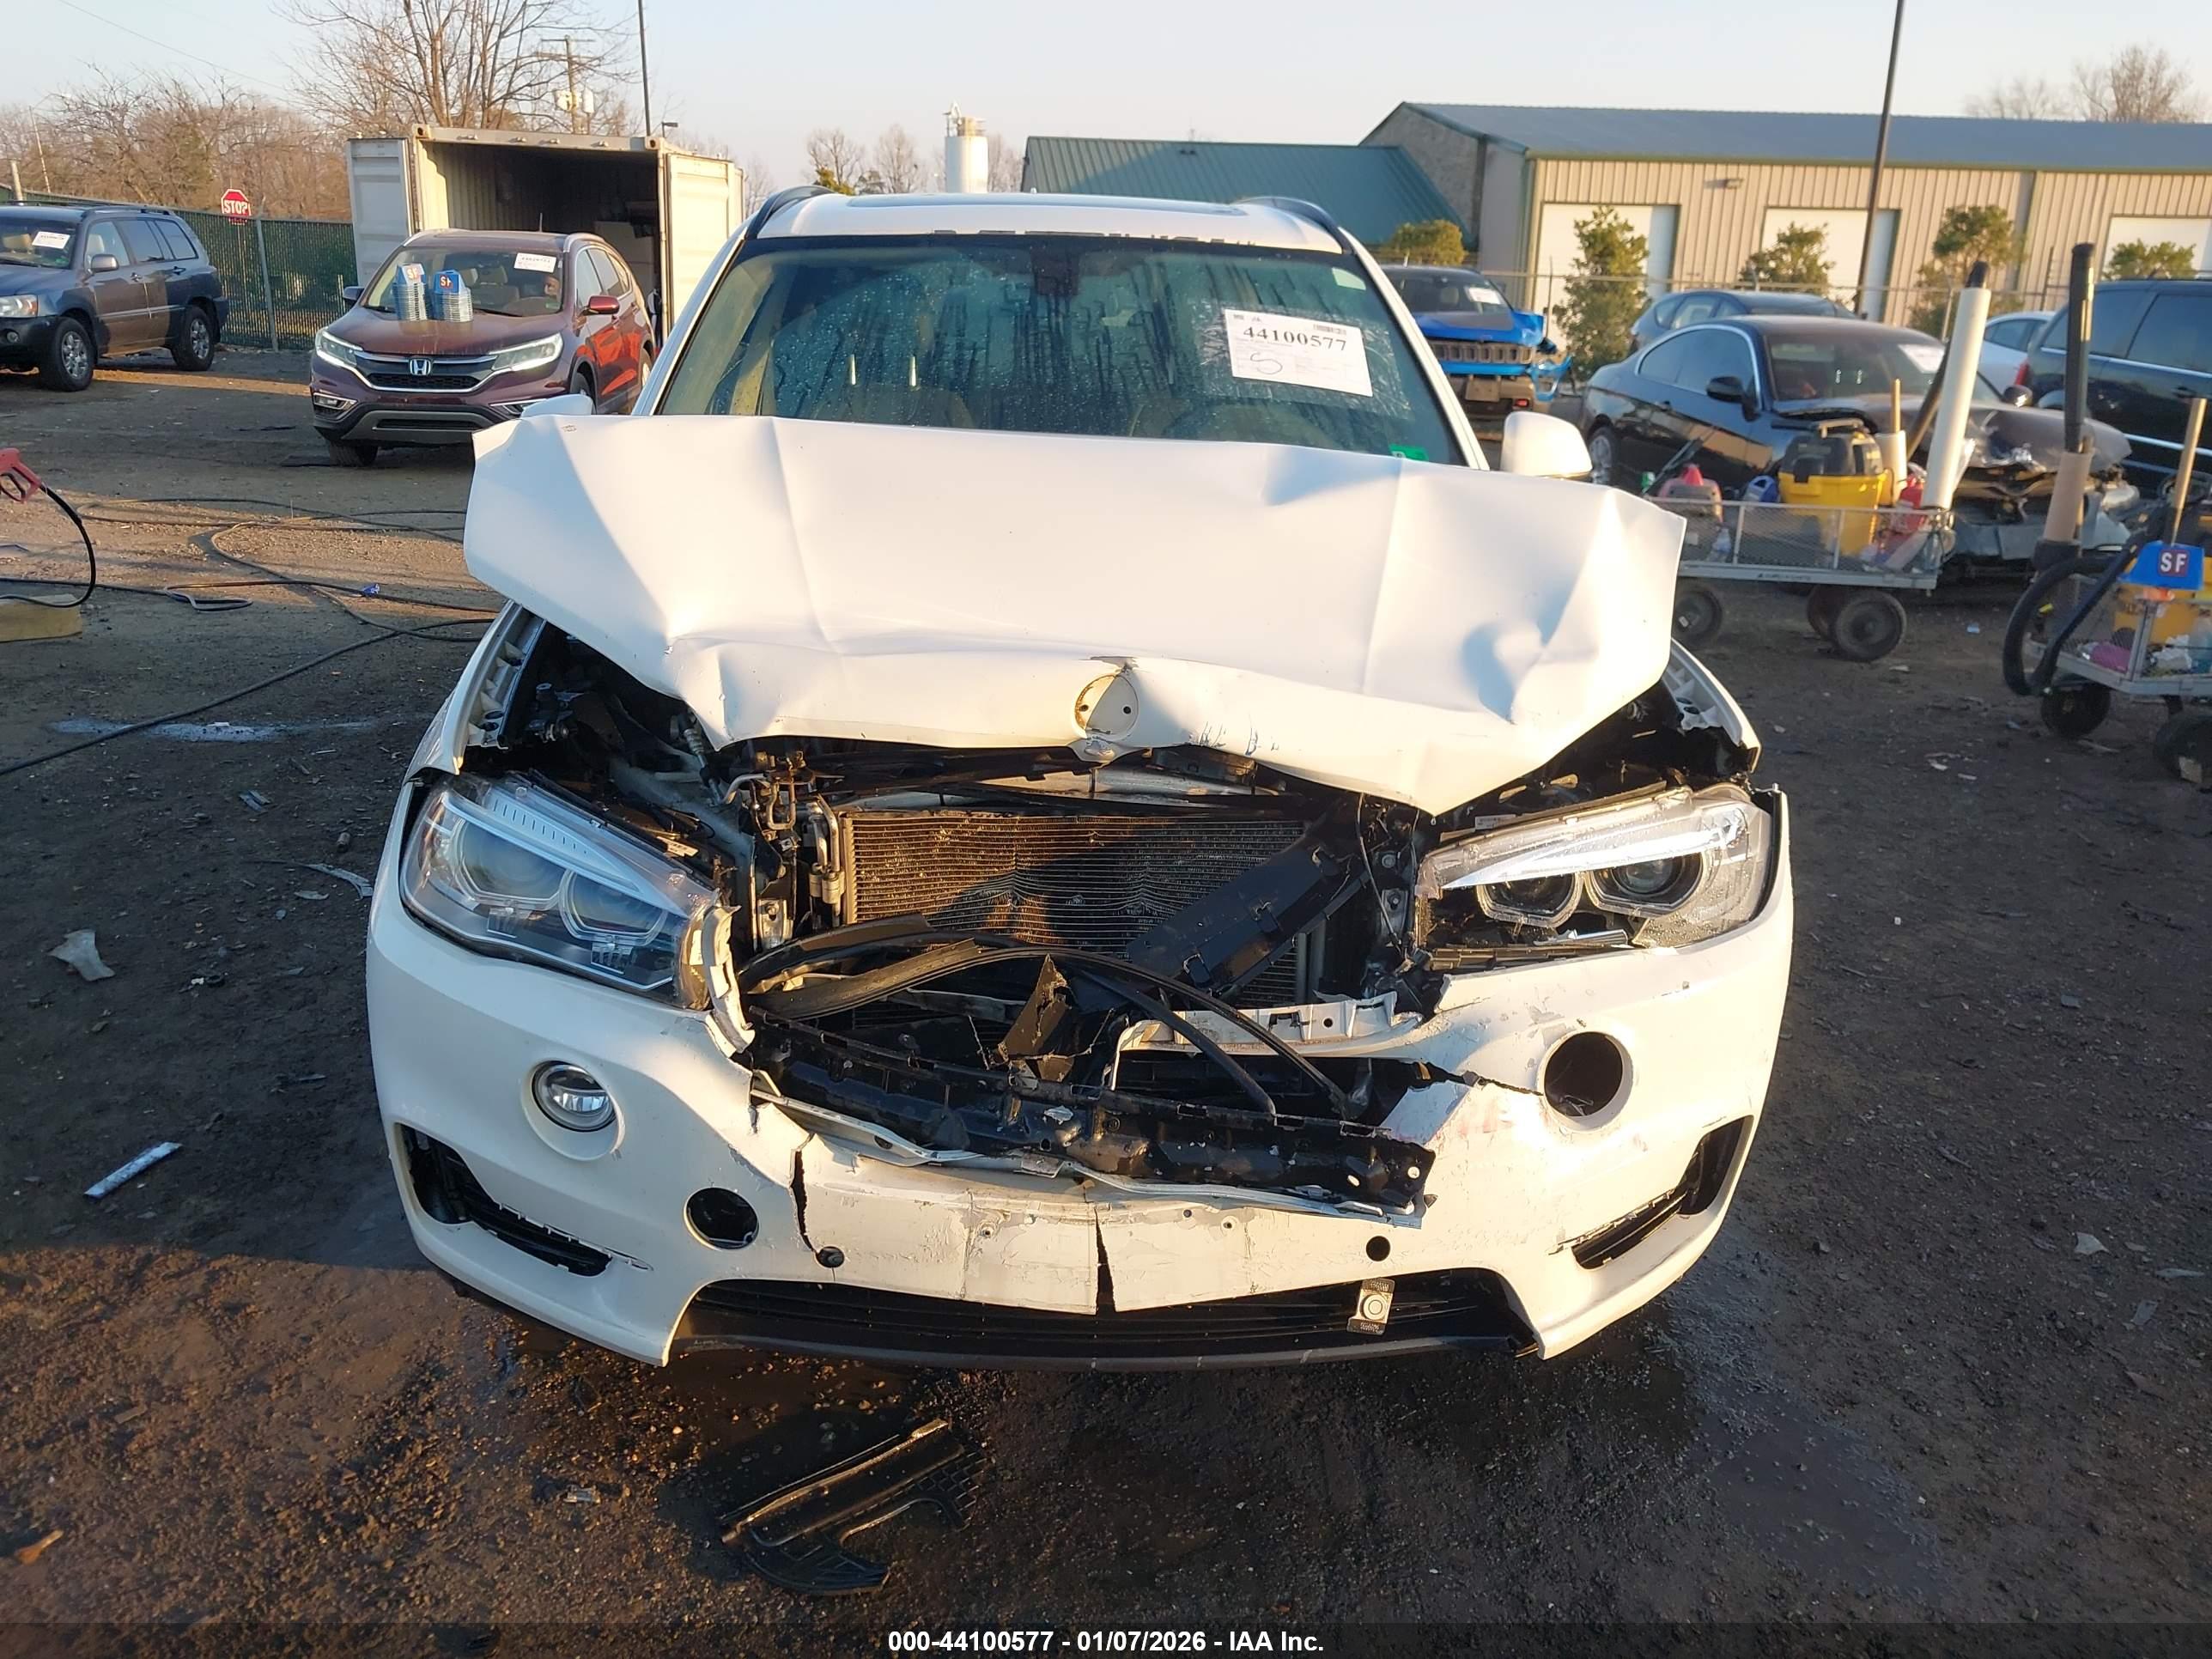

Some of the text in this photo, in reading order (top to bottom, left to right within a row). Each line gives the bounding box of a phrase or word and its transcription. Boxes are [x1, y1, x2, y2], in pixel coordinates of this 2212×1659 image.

[223, 199, 248, 215] STOP
[1243, 326, 1346, 350] 44100577
[2160, 551, 2187, 573] SF
